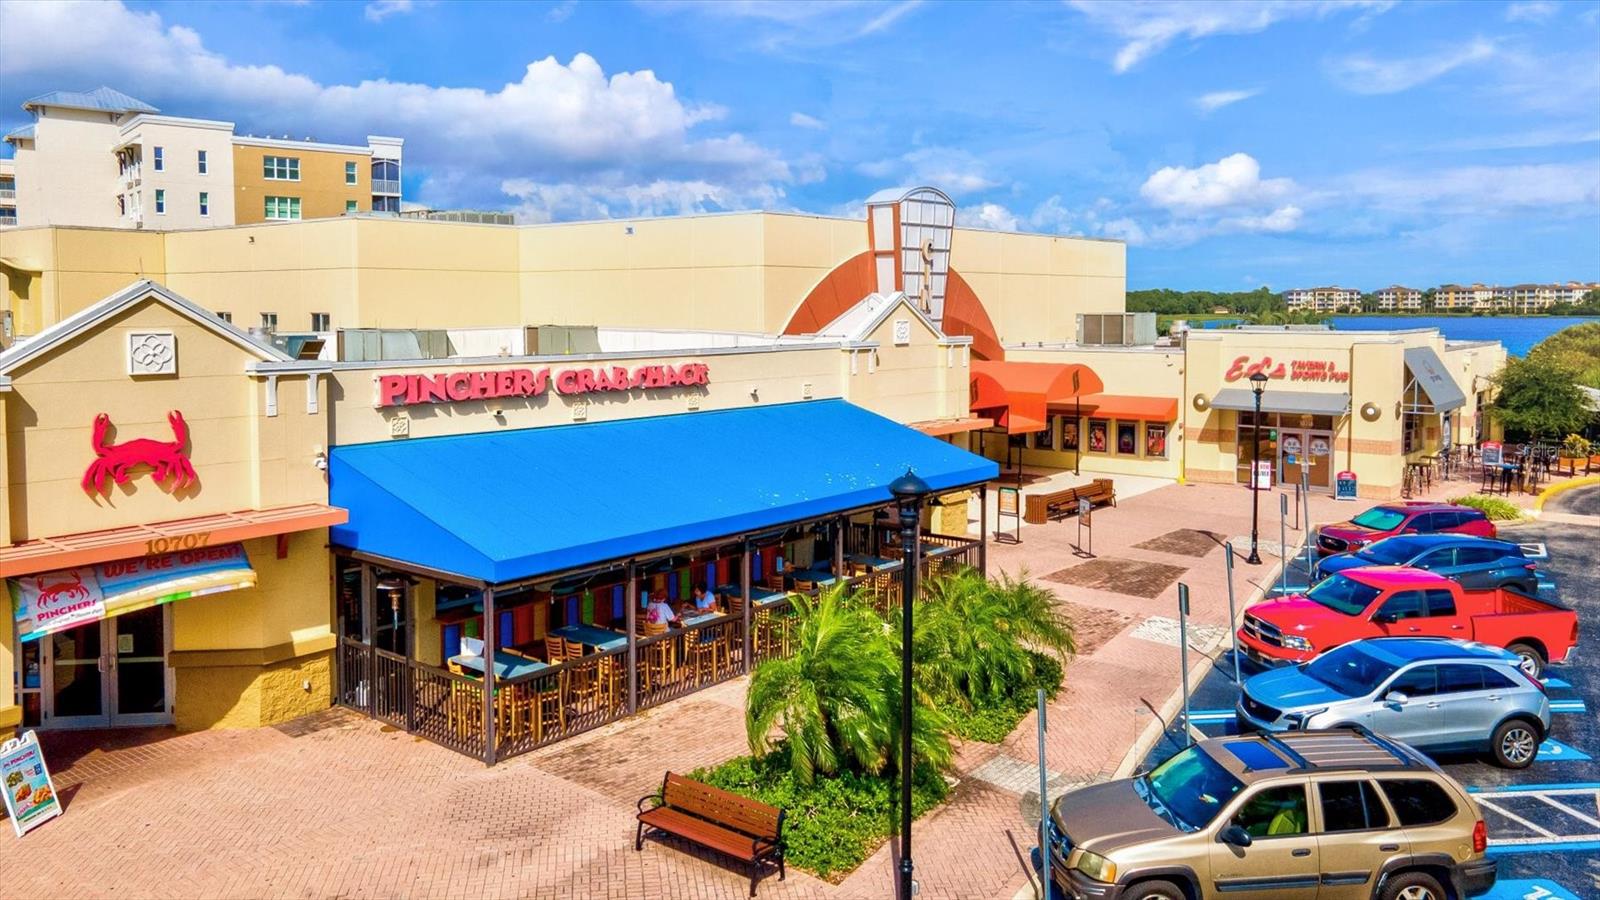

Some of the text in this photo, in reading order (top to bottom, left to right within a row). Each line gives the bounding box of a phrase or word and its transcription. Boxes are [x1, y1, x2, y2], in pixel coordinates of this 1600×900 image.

[1291, 360, 1327, 371] TAVERN
[1291, 371, 1349, 382] SPORTS PUB
[378, 363, 711, 408] PINCHERS CRAB SHACK
[145, 533, 210, 556] 10707
[103, 555, 173, 578] WE'RE
[37, 599, 97, 622] PINCHERS
